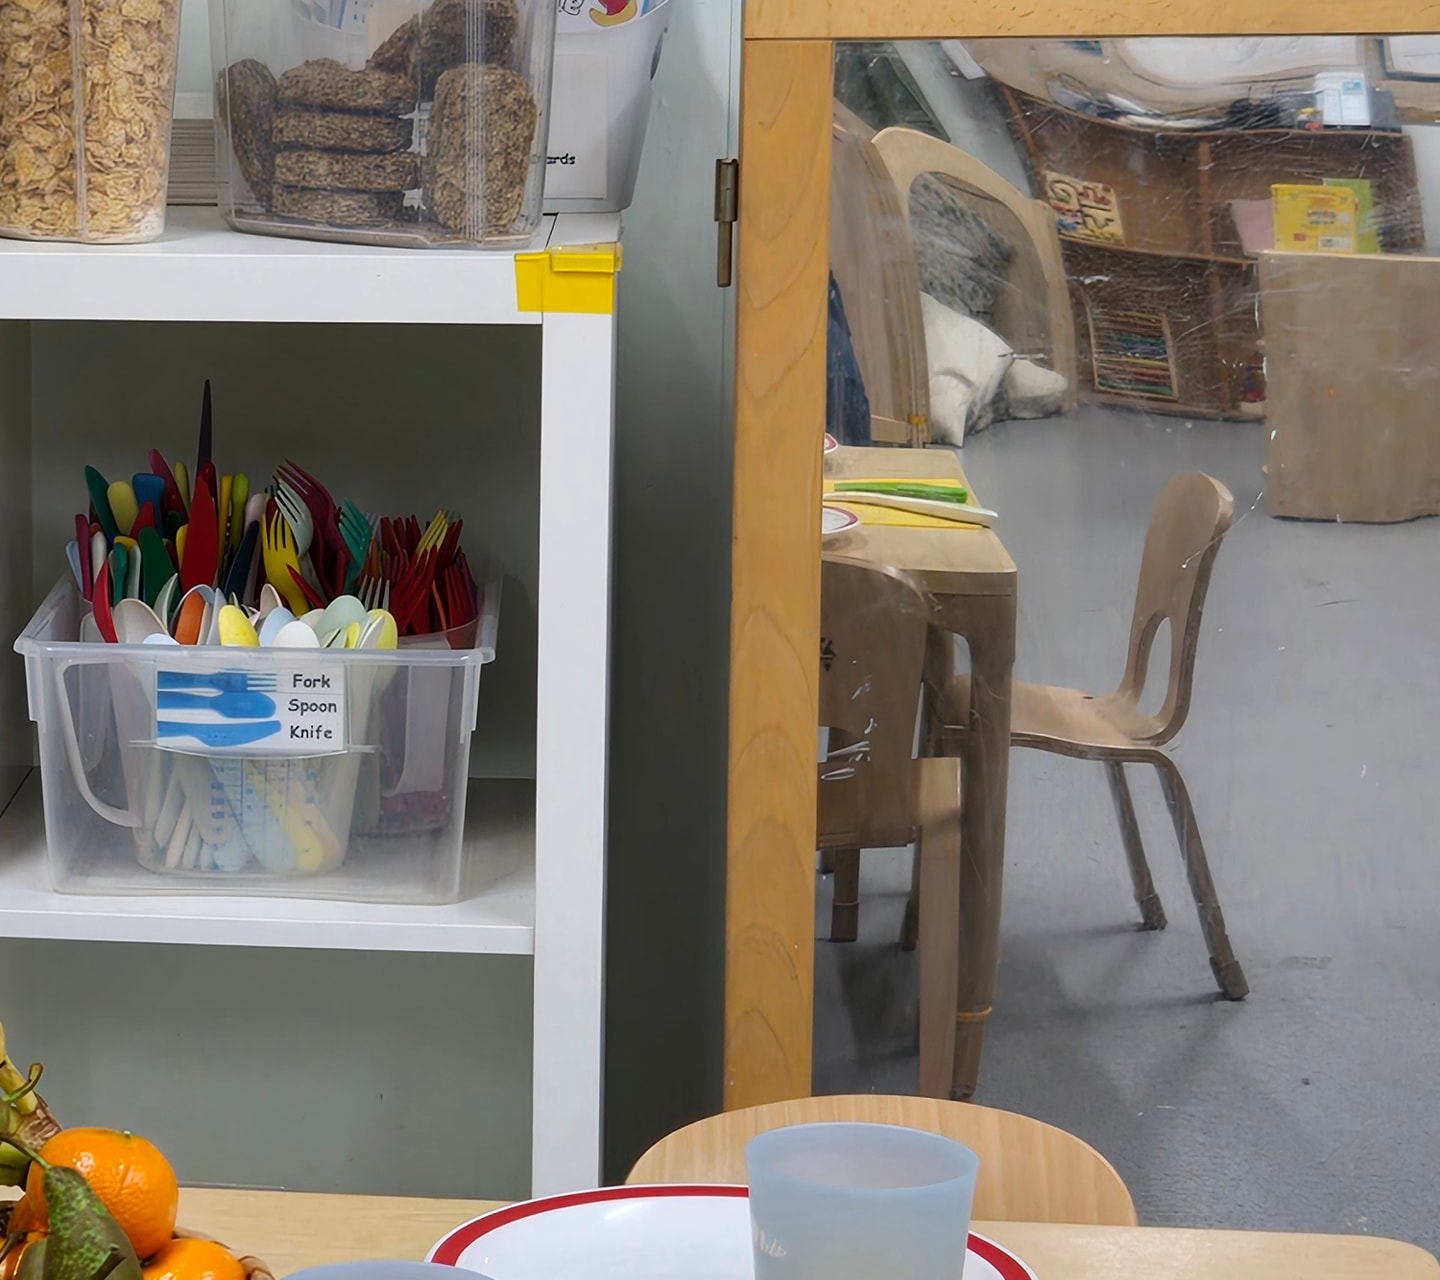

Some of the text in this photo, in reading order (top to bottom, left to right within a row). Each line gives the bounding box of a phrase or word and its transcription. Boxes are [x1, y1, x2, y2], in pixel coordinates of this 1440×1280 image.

[292, 673, 331, 688] Fork
[287, 698, 337, 716] Spoon
[289, 725, 333, 739] Knife
